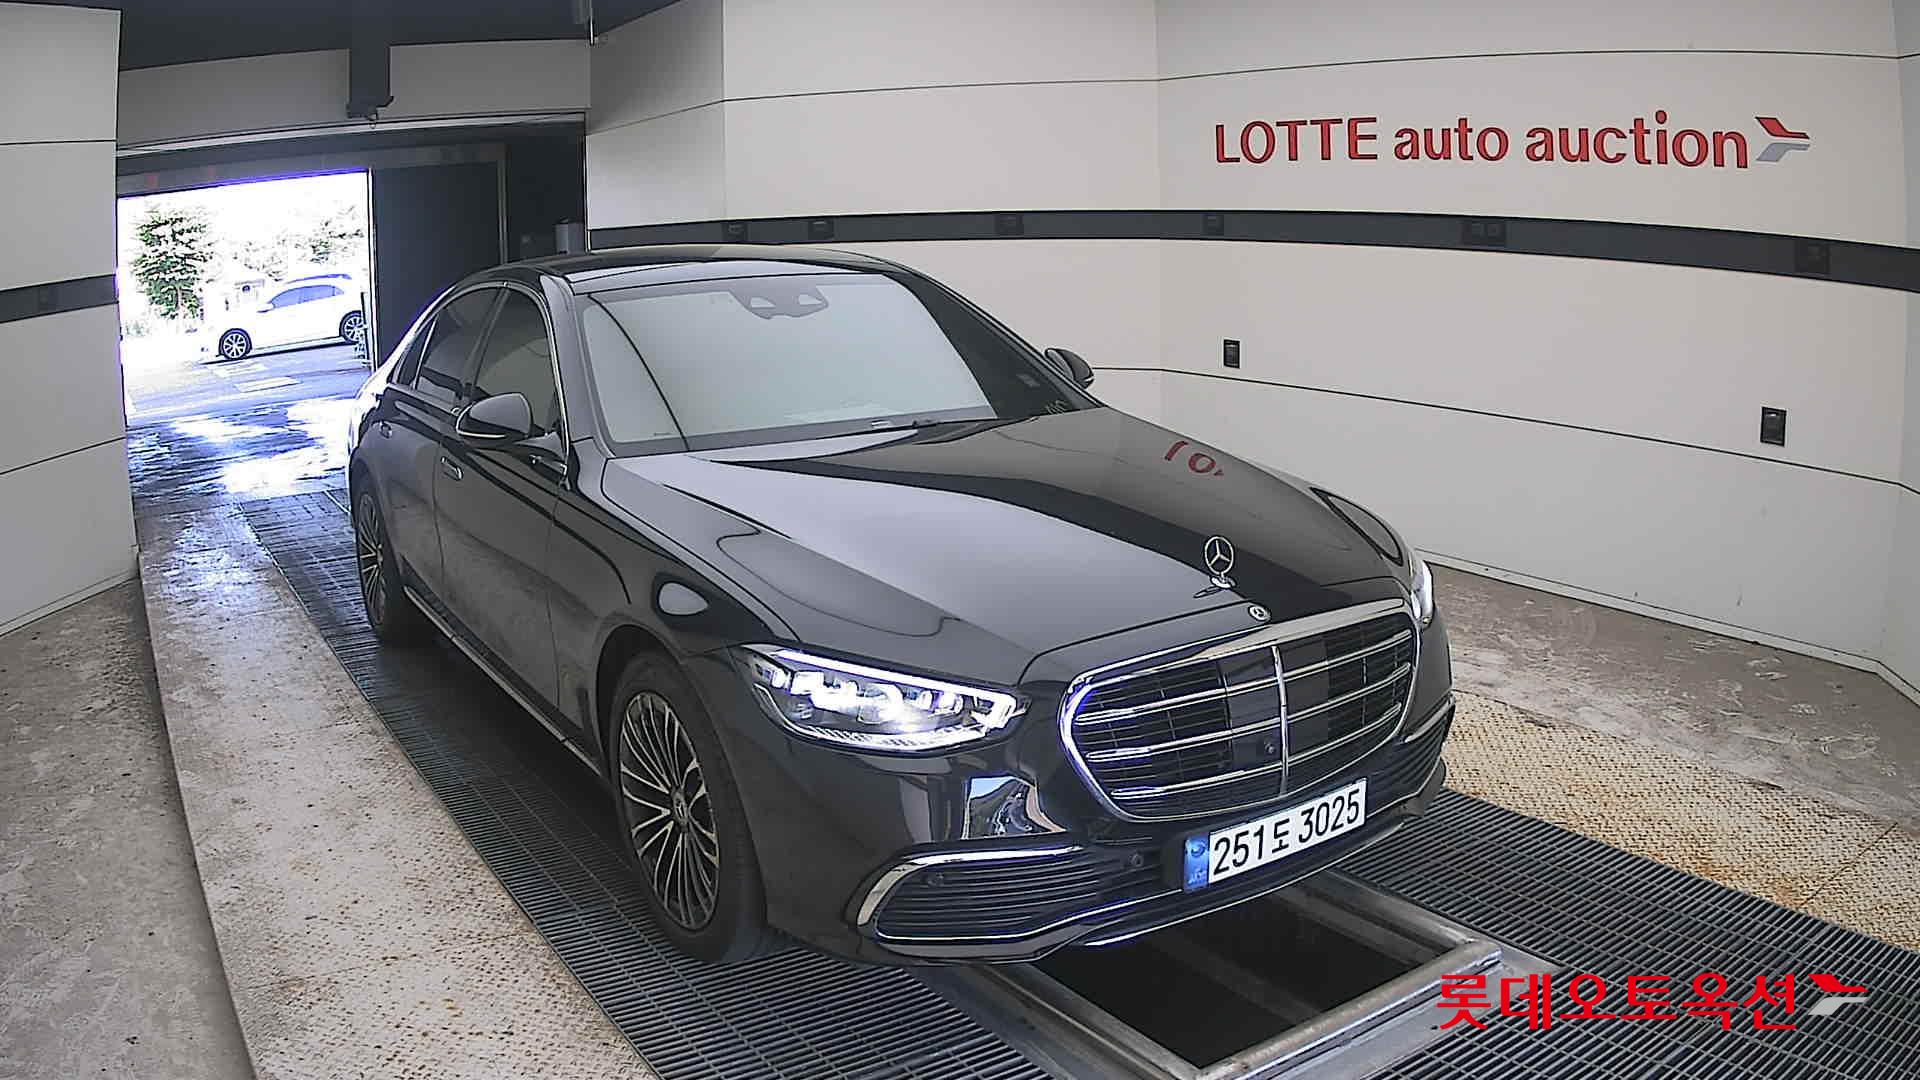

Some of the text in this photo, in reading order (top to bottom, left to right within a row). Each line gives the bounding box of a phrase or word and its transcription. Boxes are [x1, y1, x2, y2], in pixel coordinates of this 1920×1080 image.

[1215, 110, 1748, 169] LOTTE auto auction
[1213, 788, 1361, 876] 251도 3025
